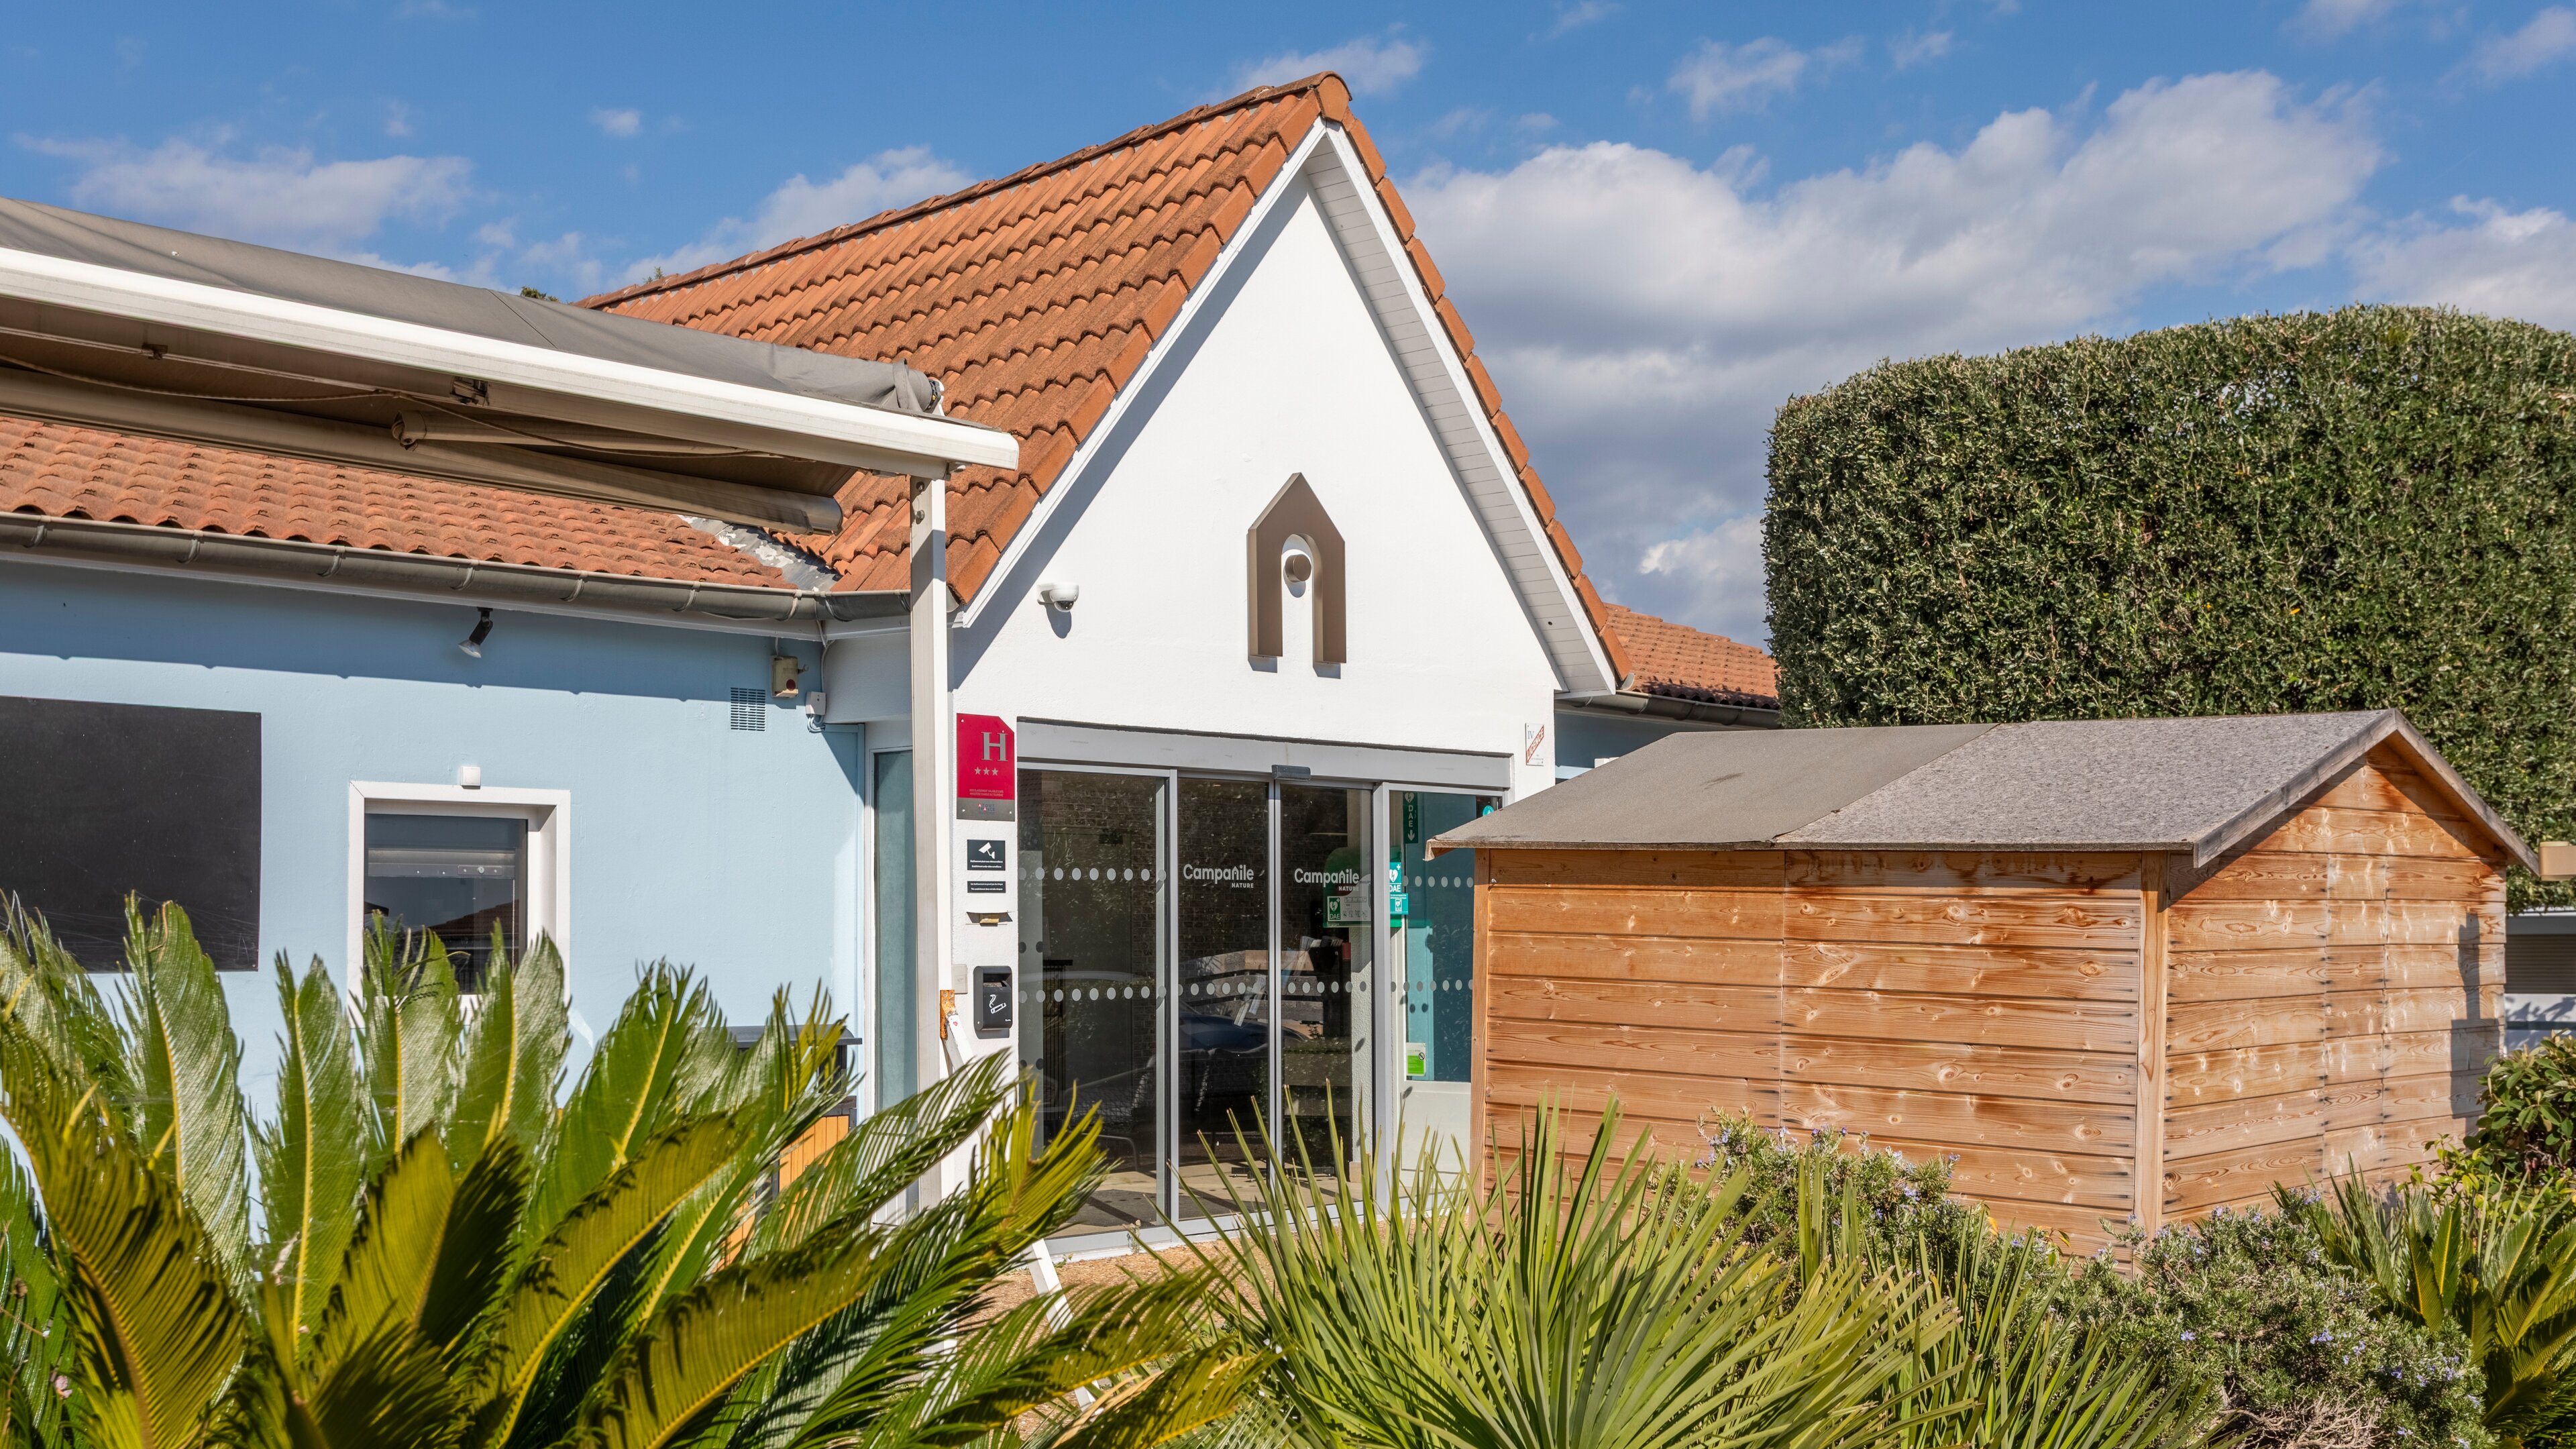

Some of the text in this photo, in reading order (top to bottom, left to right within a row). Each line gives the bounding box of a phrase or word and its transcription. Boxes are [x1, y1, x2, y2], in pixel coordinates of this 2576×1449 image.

[981, 732, 1008, 761] H
[1183, 863, 1254, 885] Campanile
[1294, 867, 1360, 888] Campanile
